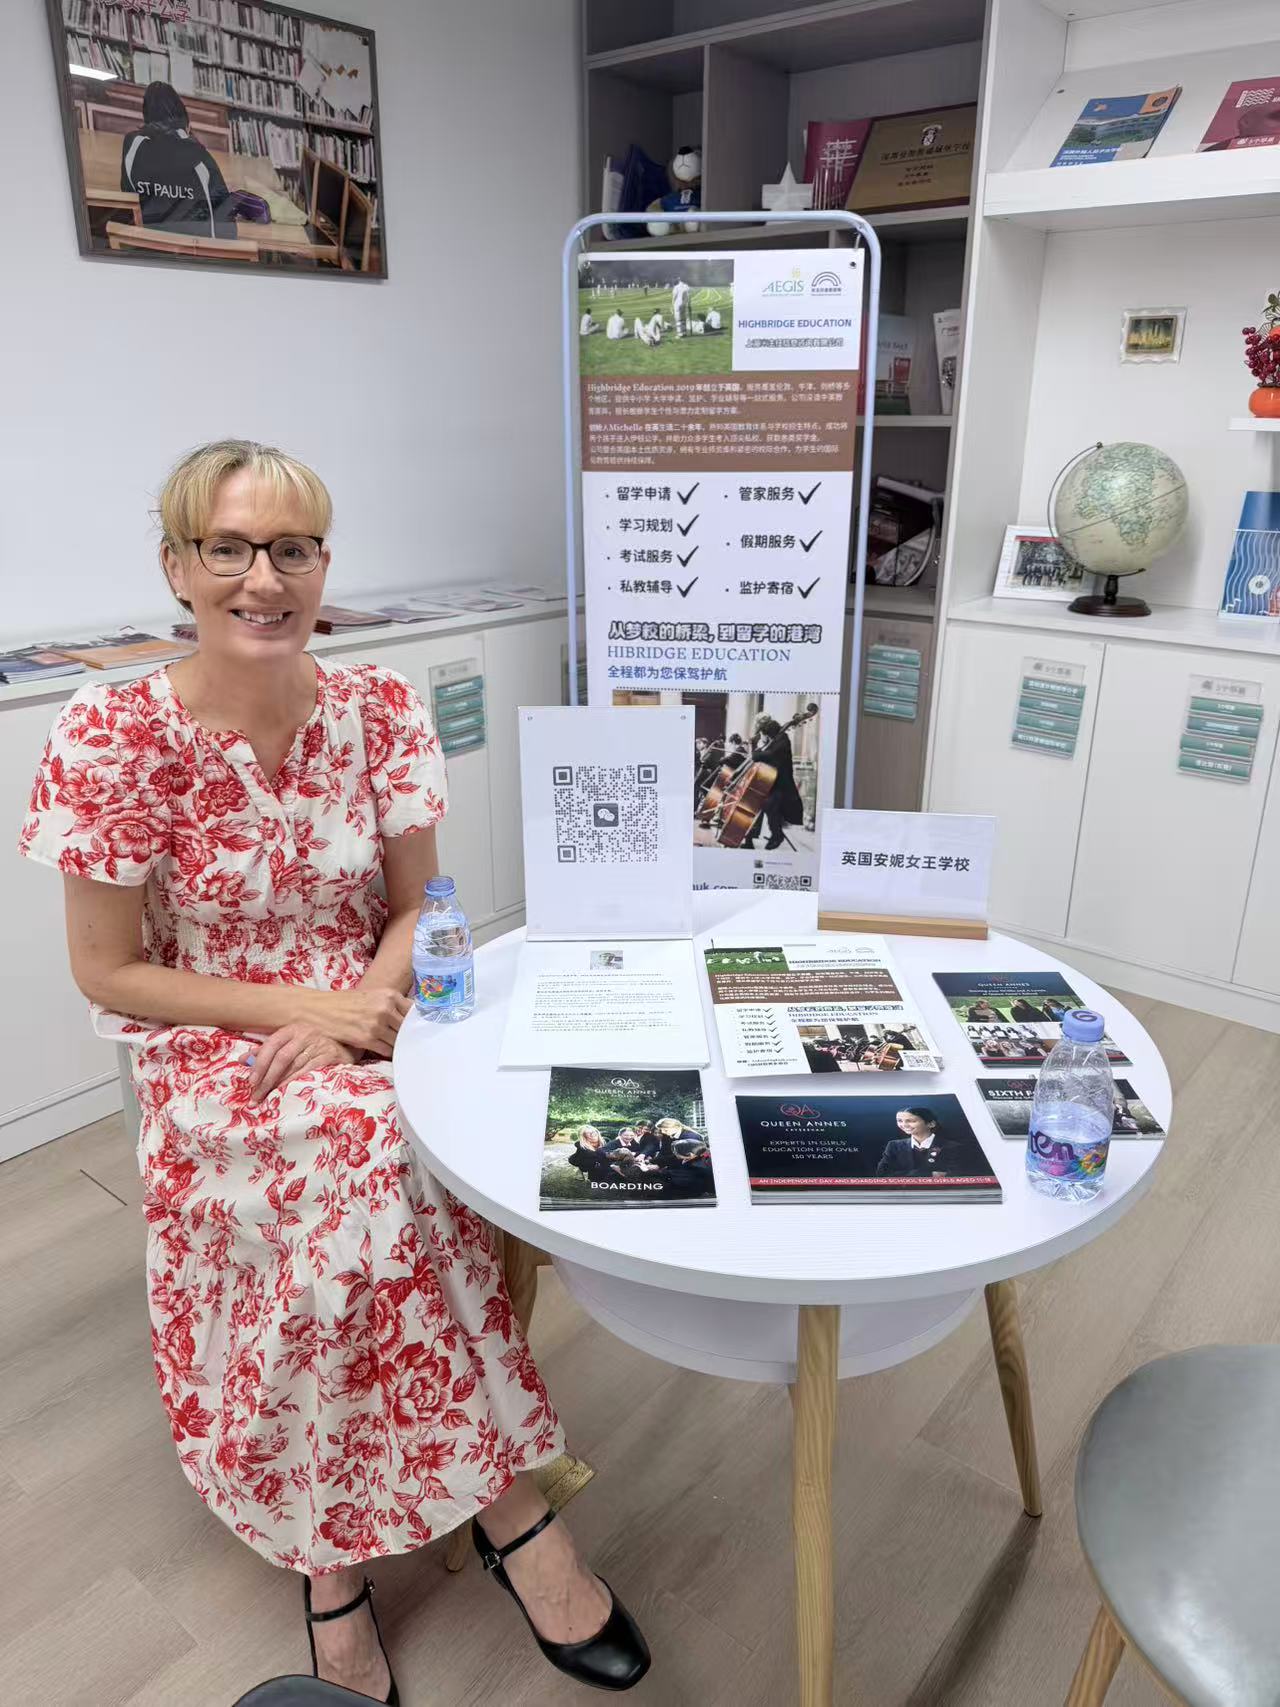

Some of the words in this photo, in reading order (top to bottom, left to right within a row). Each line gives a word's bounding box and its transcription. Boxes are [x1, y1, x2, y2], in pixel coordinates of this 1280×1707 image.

[138, 181, 150, 196] ST
[154, 183, 194, 200] PAUL'S
[762, 280, 805, 293] AEGIS
[738, 320, 795, 329] HIGHBRIDGE
[797, 319, 852, 328] EDUCATION
[587, 384, 631, 393] Highbridge
[632, 383, 674, 392] Education
[617, 487, 671, 501] 留学申请
[739, 487, 795, 501] 管家服务
[619, 518, 673, 532] 学习规划
[740, 535, 796, 549] 假期服务
[619, 549, 673, 563] 考试服务
[619, 580, 673, 594] 私教辅导
[739, 581, 794, 595] 监护寄宿
[608, 645, 687, 660] HIBRIDGE
[692, 647, 791, 661] EDUCATION
[607, 665, 728, 681] 全程都为您保驾护航
[841, 851, 970, 872] 英国安妮女王学校
[590, 1181, 664, 1191] BOARDING
